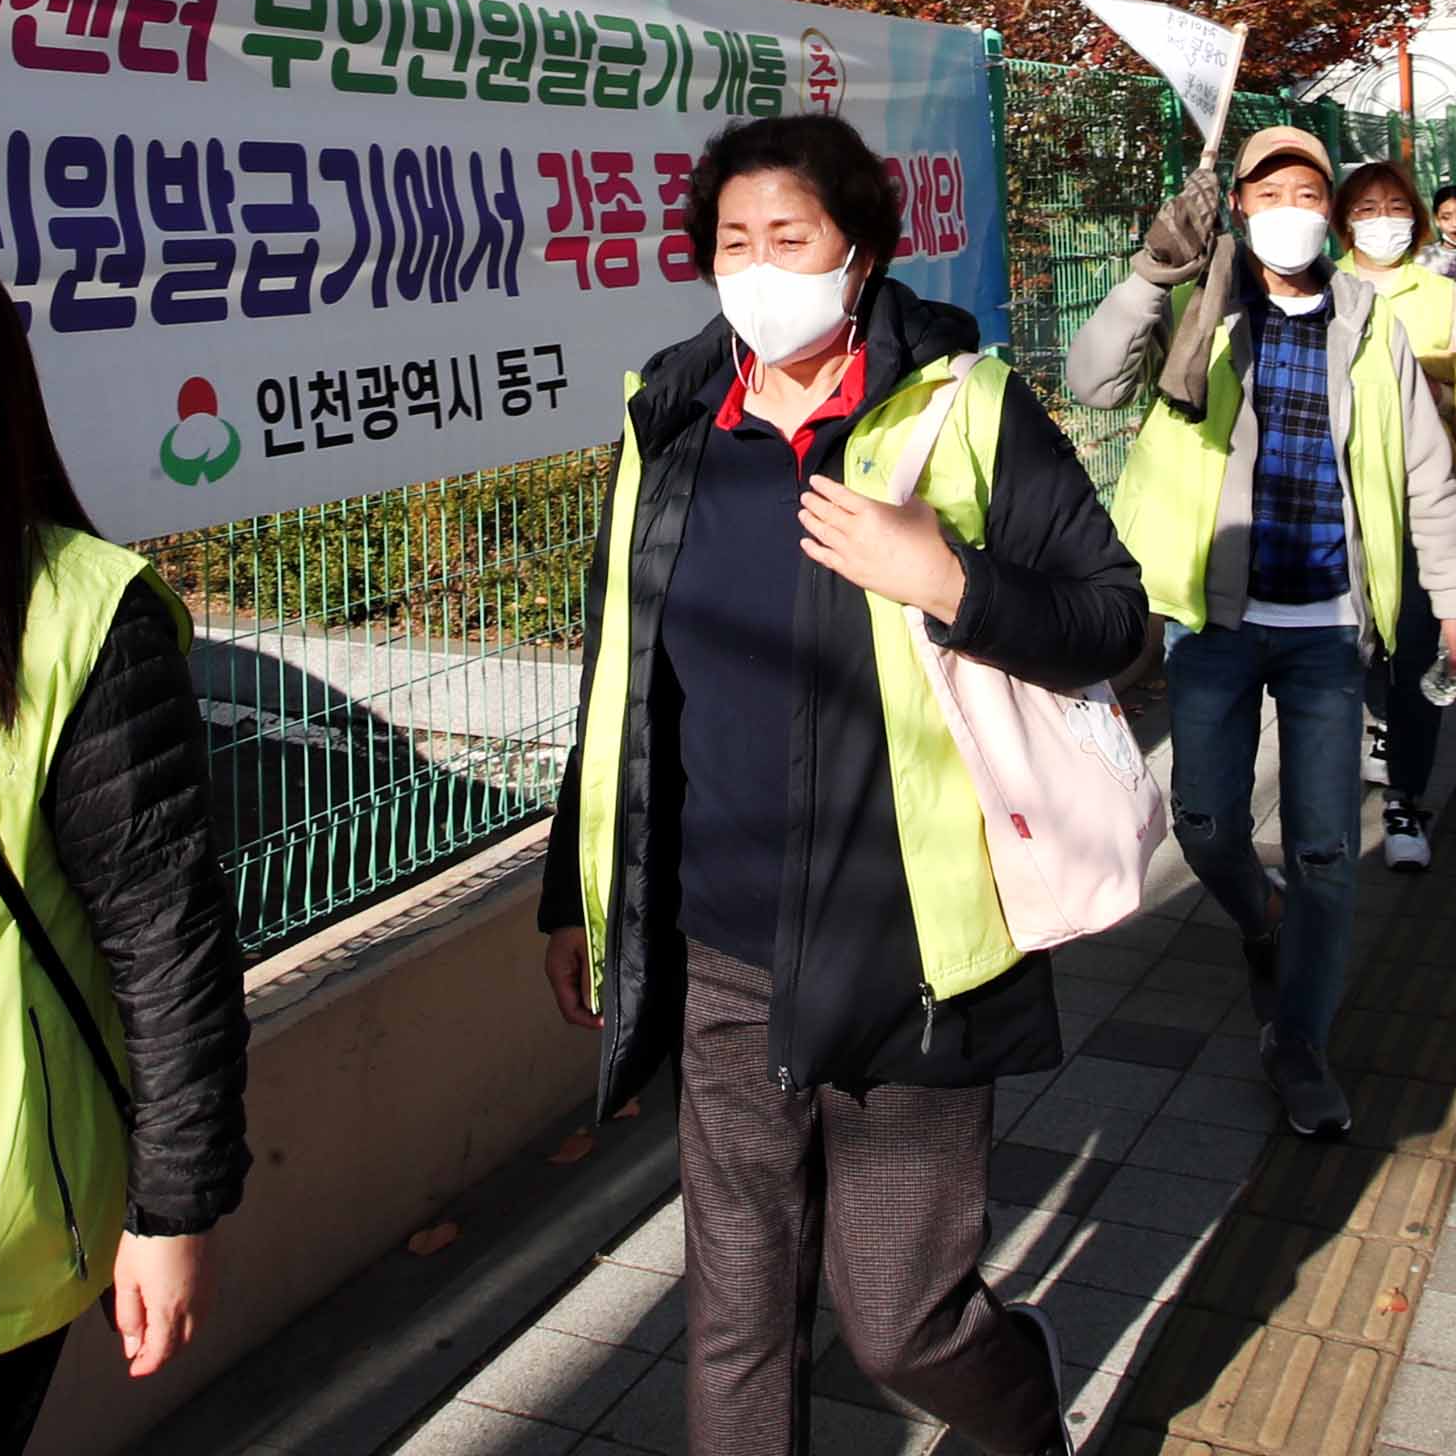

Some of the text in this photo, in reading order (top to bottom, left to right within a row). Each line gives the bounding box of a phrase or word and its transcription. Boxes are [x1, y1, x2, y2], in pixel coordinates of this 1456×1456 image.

[703, 30, 786, 117] 개통
[808, 43, 838, 118] 축
[537, 149, 647, 290] 각종
[256, 344, 568, 458] 인천광역시 동구
